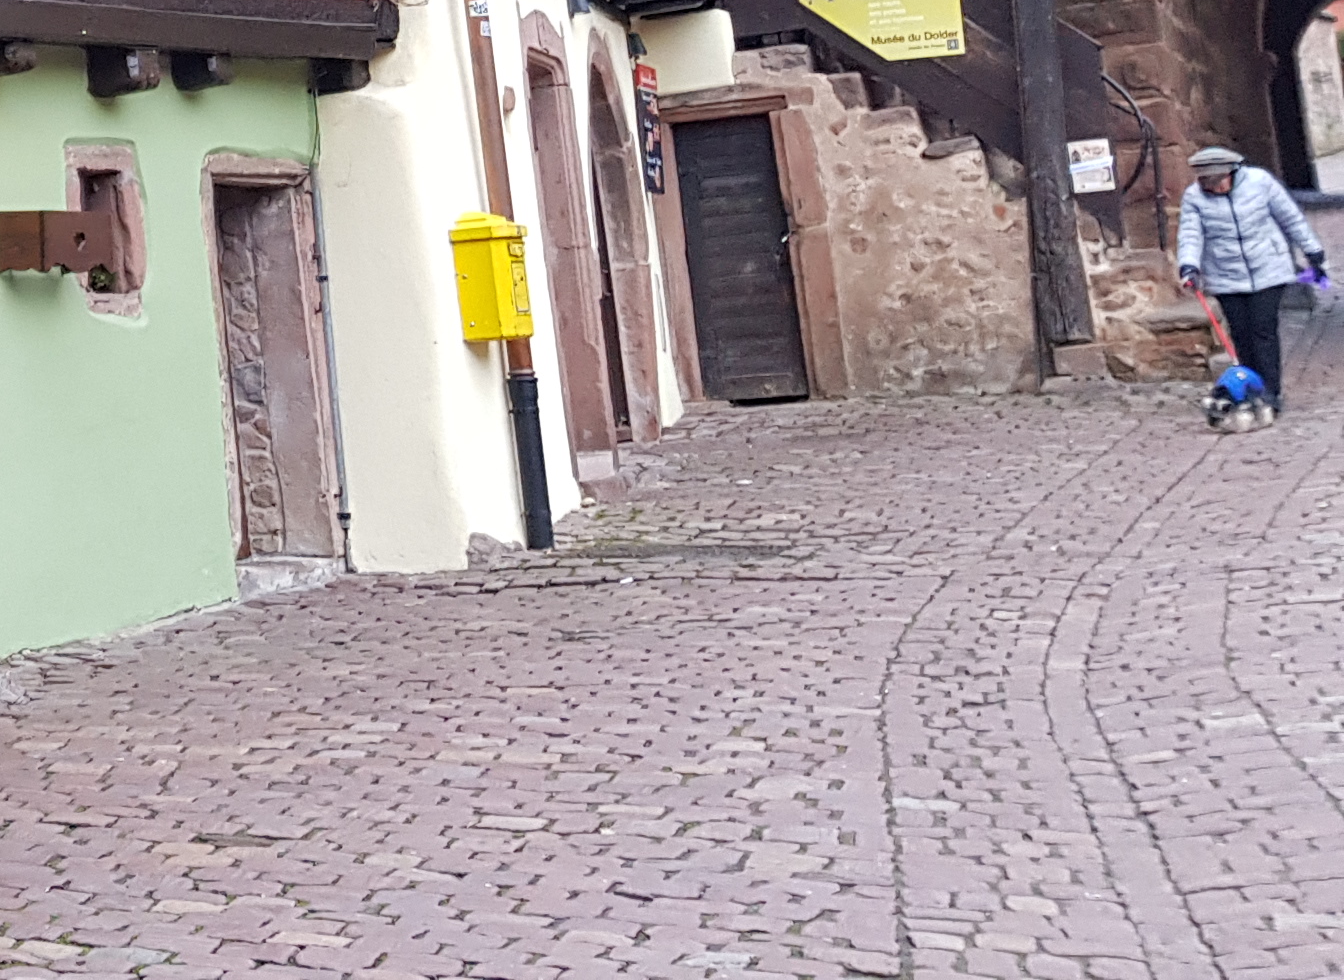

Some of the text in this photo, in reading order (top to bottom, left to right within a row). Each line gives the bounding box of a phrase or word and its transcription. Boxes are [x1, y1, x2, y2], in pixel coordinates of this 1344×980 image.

[871, 29, 959, 45] Musée du Dolder
